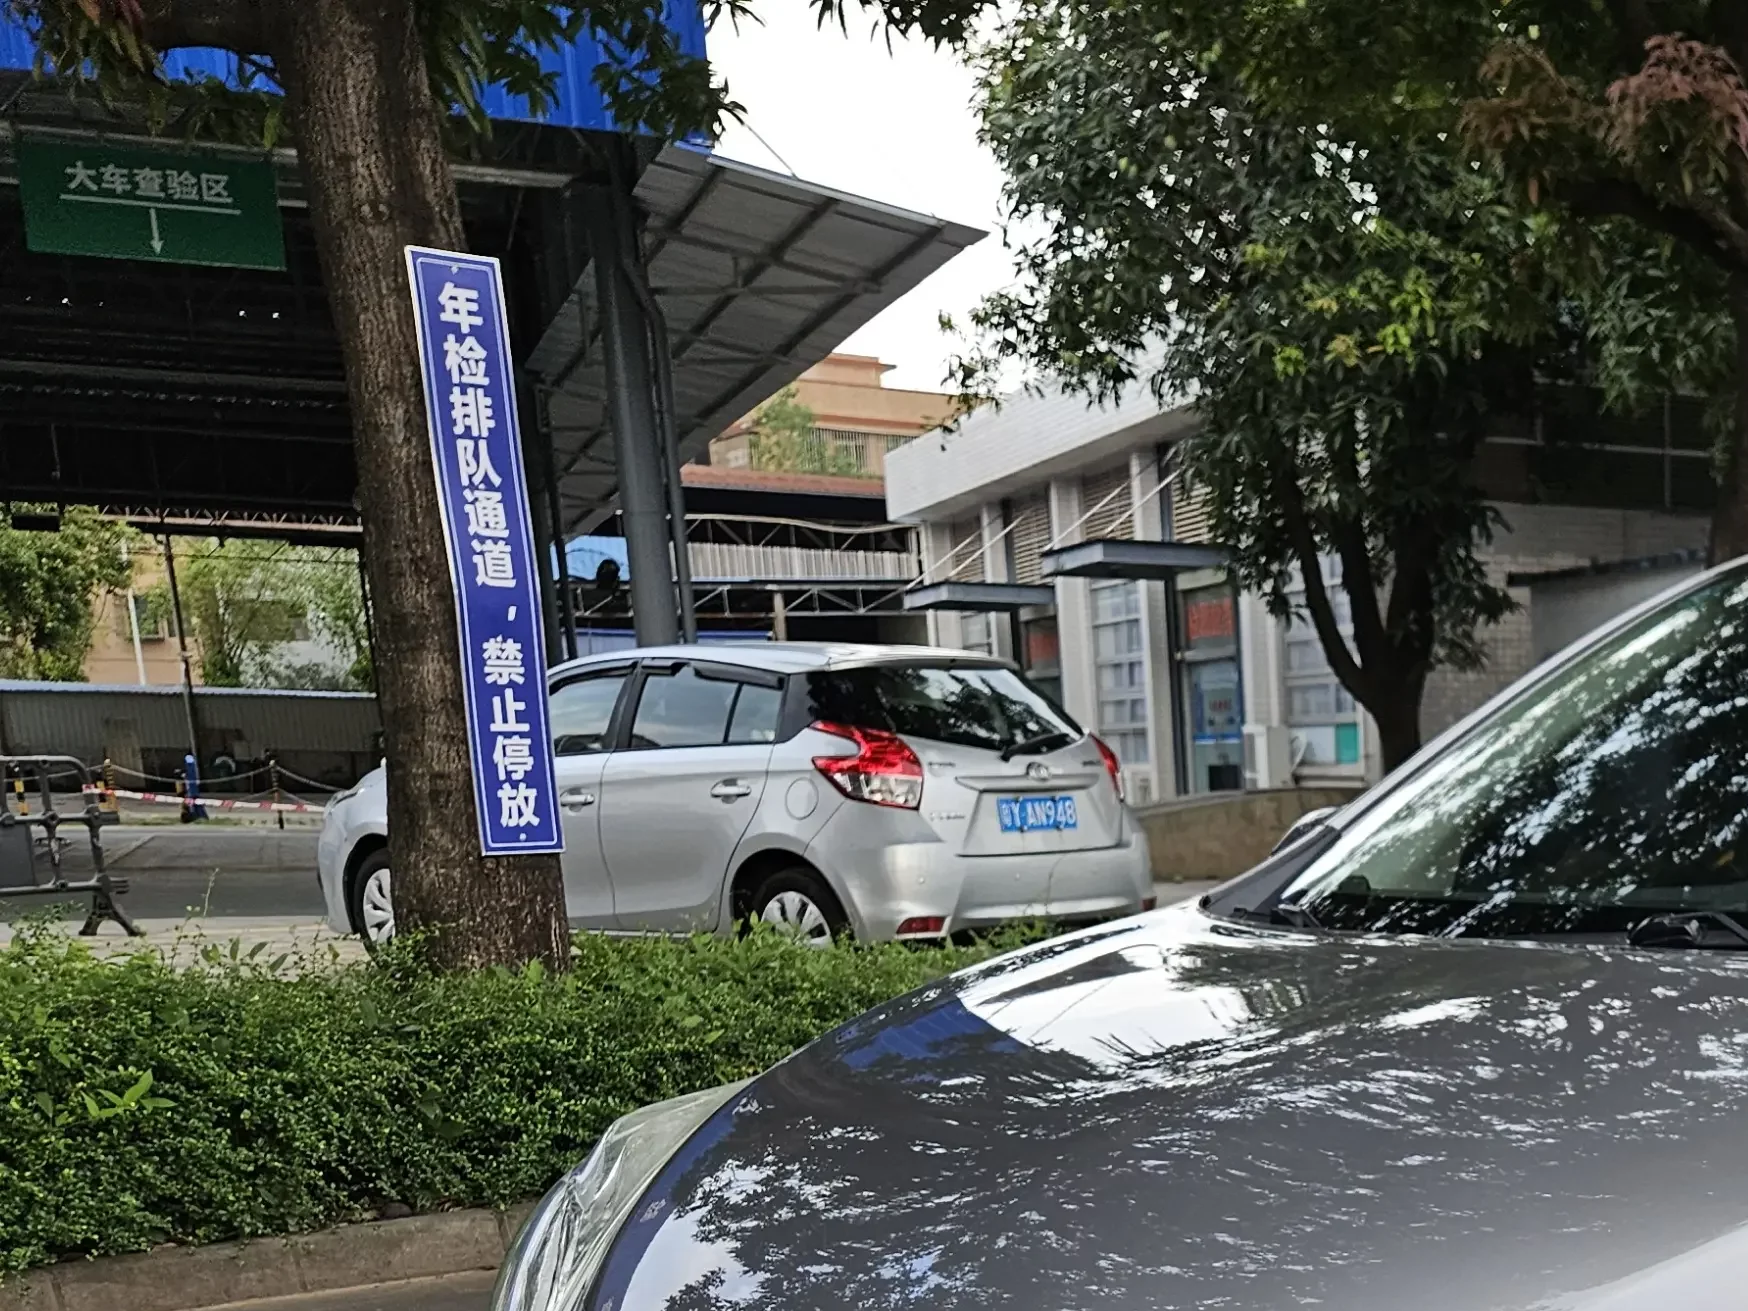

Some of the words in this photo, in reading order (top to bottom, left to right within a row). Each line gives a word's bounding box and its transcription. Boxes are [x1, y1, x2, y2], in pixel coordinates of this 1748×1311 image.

[64, 160, 233, 203] 大车查验区
